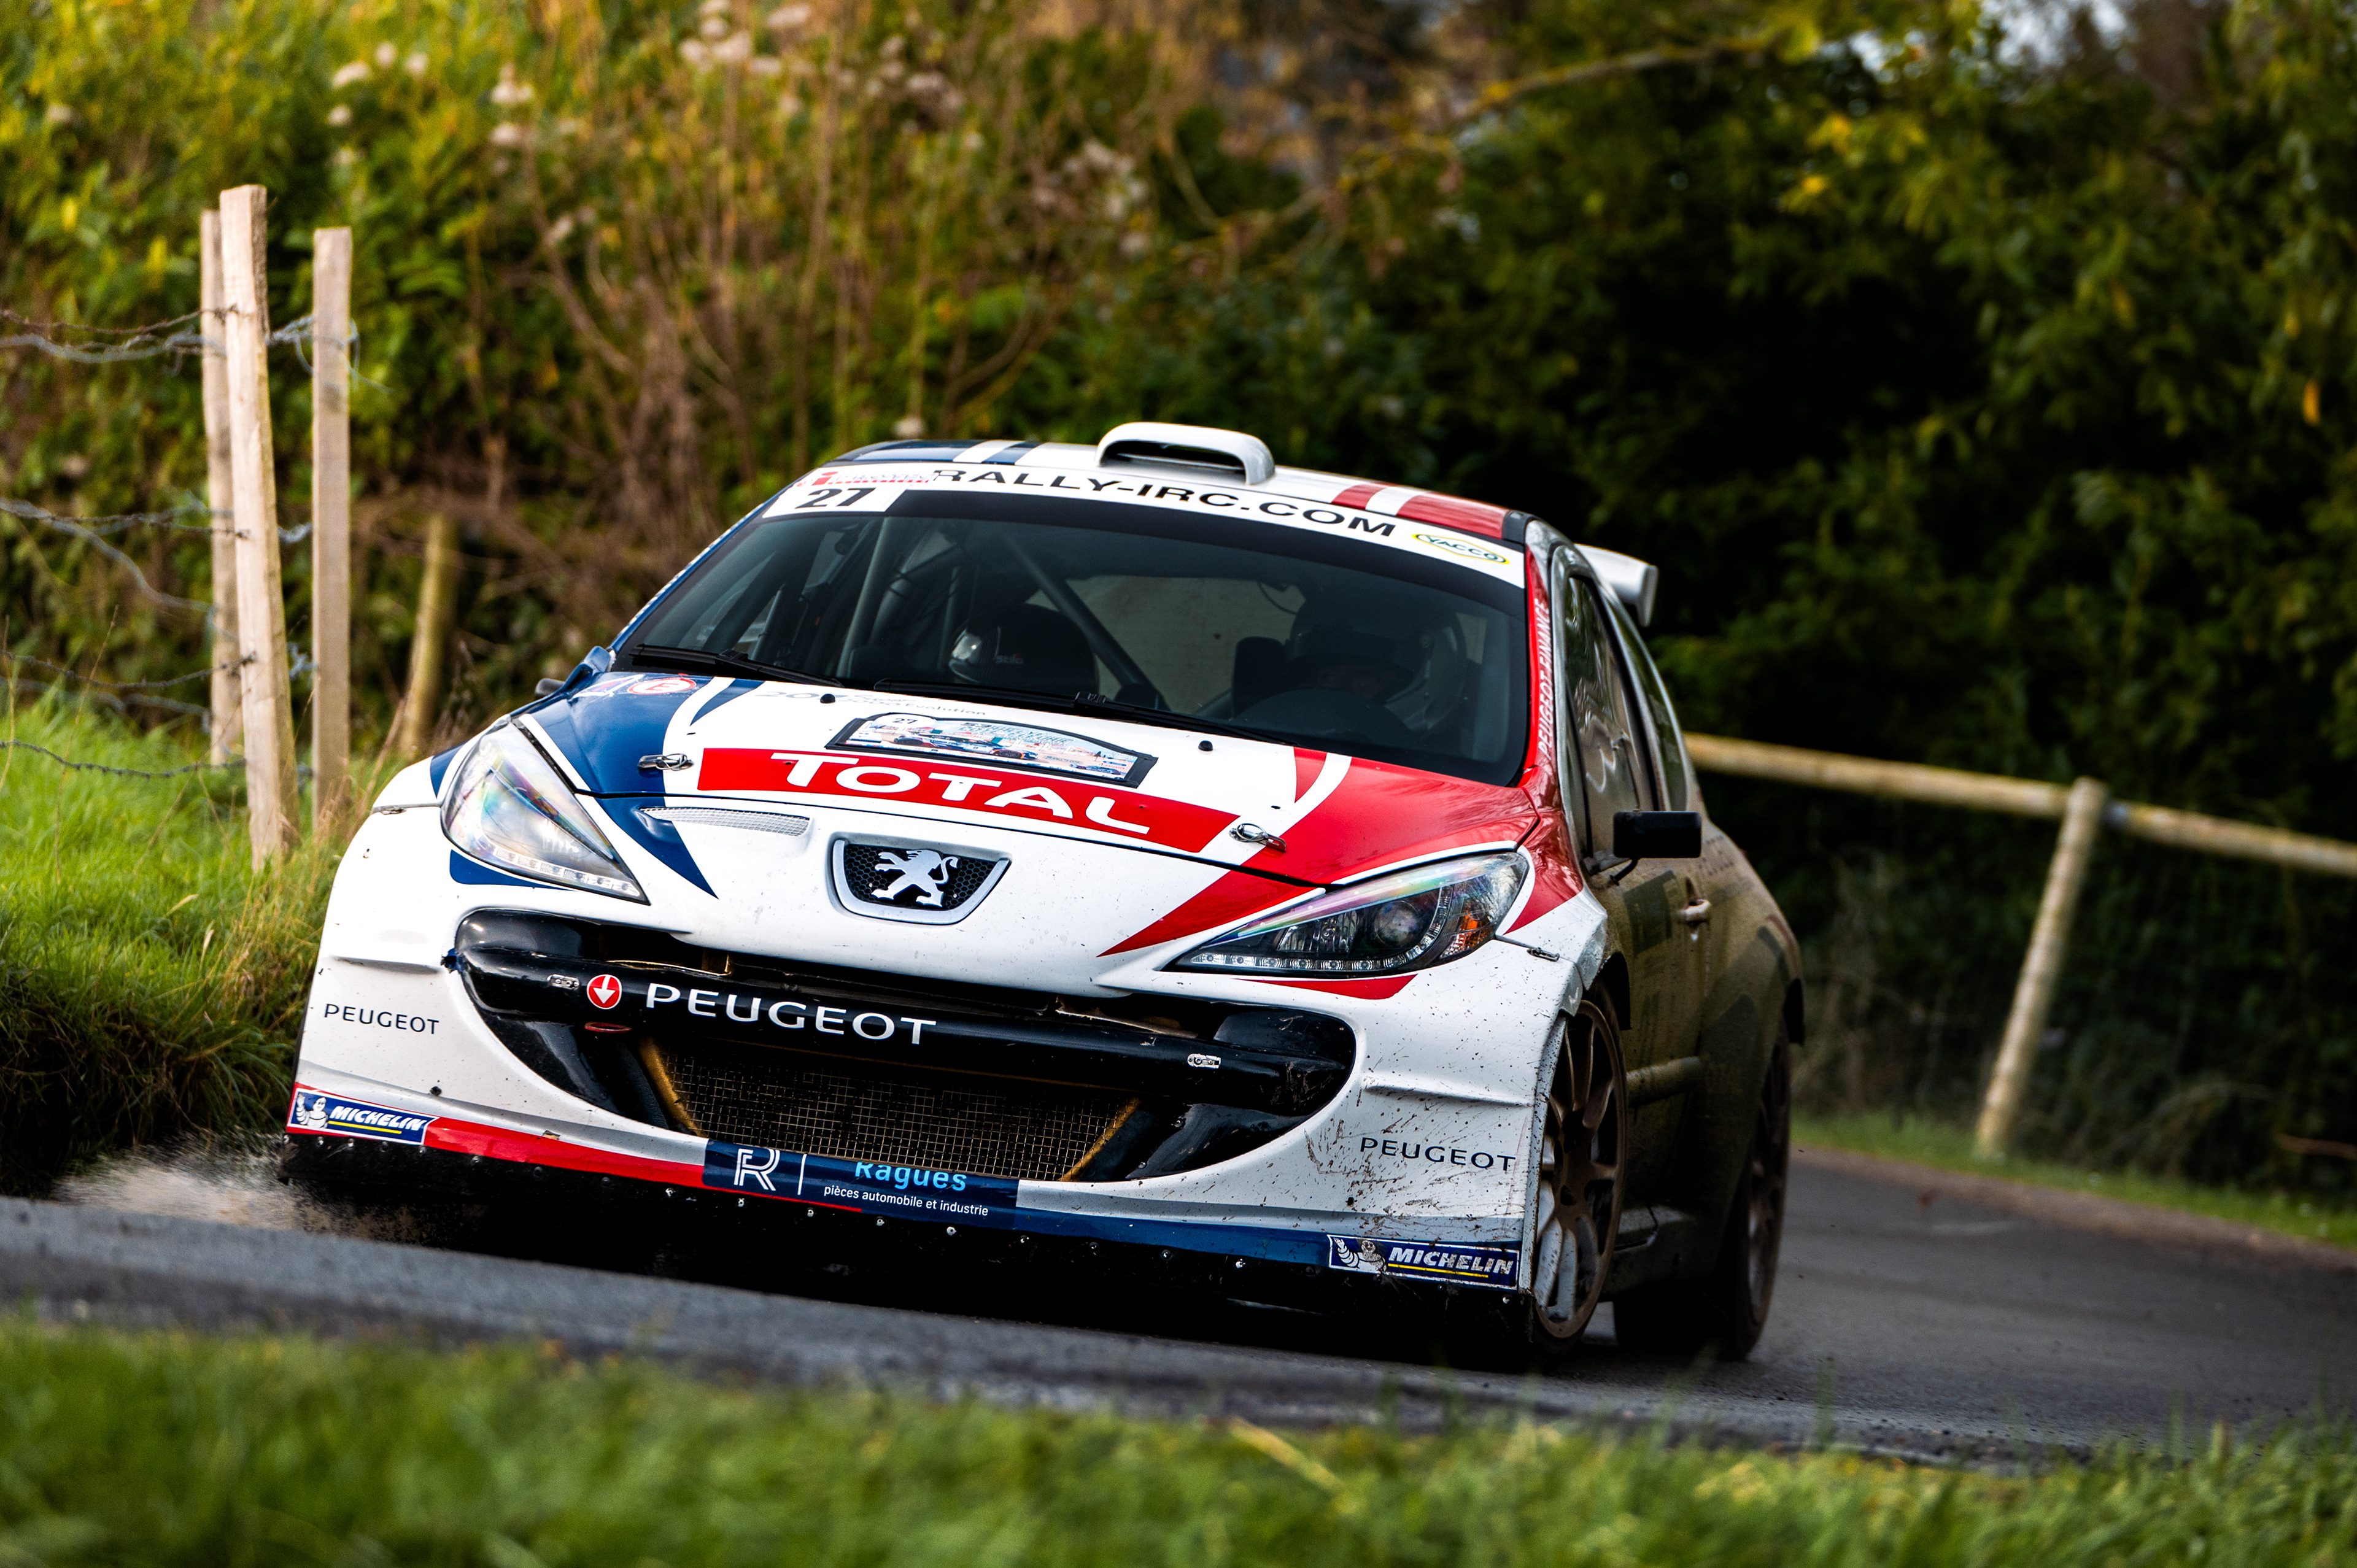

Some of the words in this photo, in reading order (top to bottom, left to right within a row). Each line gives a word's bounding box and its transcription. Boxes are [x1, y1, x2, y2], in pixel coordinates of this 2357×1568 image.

[795, 487, 877, 509] 27
[933, 469, 1396, 537] RALLY-IRC.COM
[1425, 535, 1498, 560] YACCO
[1534, 598, 1553, 674] FINANCE
[644, 682, 680, 691] E
[905, 703, 986, 716] Evolution
[1538, 670, 1554, 760] PEUGEOT
[770, 752, 1150, 835] TOTAL
[323, 1002, 440, 1035] PEUGEOT
[646, 983, 937, 1045] PEUGEOT
[329, 1106, 428, 1131] MICHELIN
[1360, 1137, 1516, 1172] PEUGEOT
[854, 1162, 967, 1192] Ragues
[823, 1185, 859, 1199] pièces
[862, 1191, 923, 1208] automobile
[926, 1199, 937, 1210] et
[940, 1200, 989, 1216] industrie
[1388, 1246, 1514, 1275] MICHELIN
